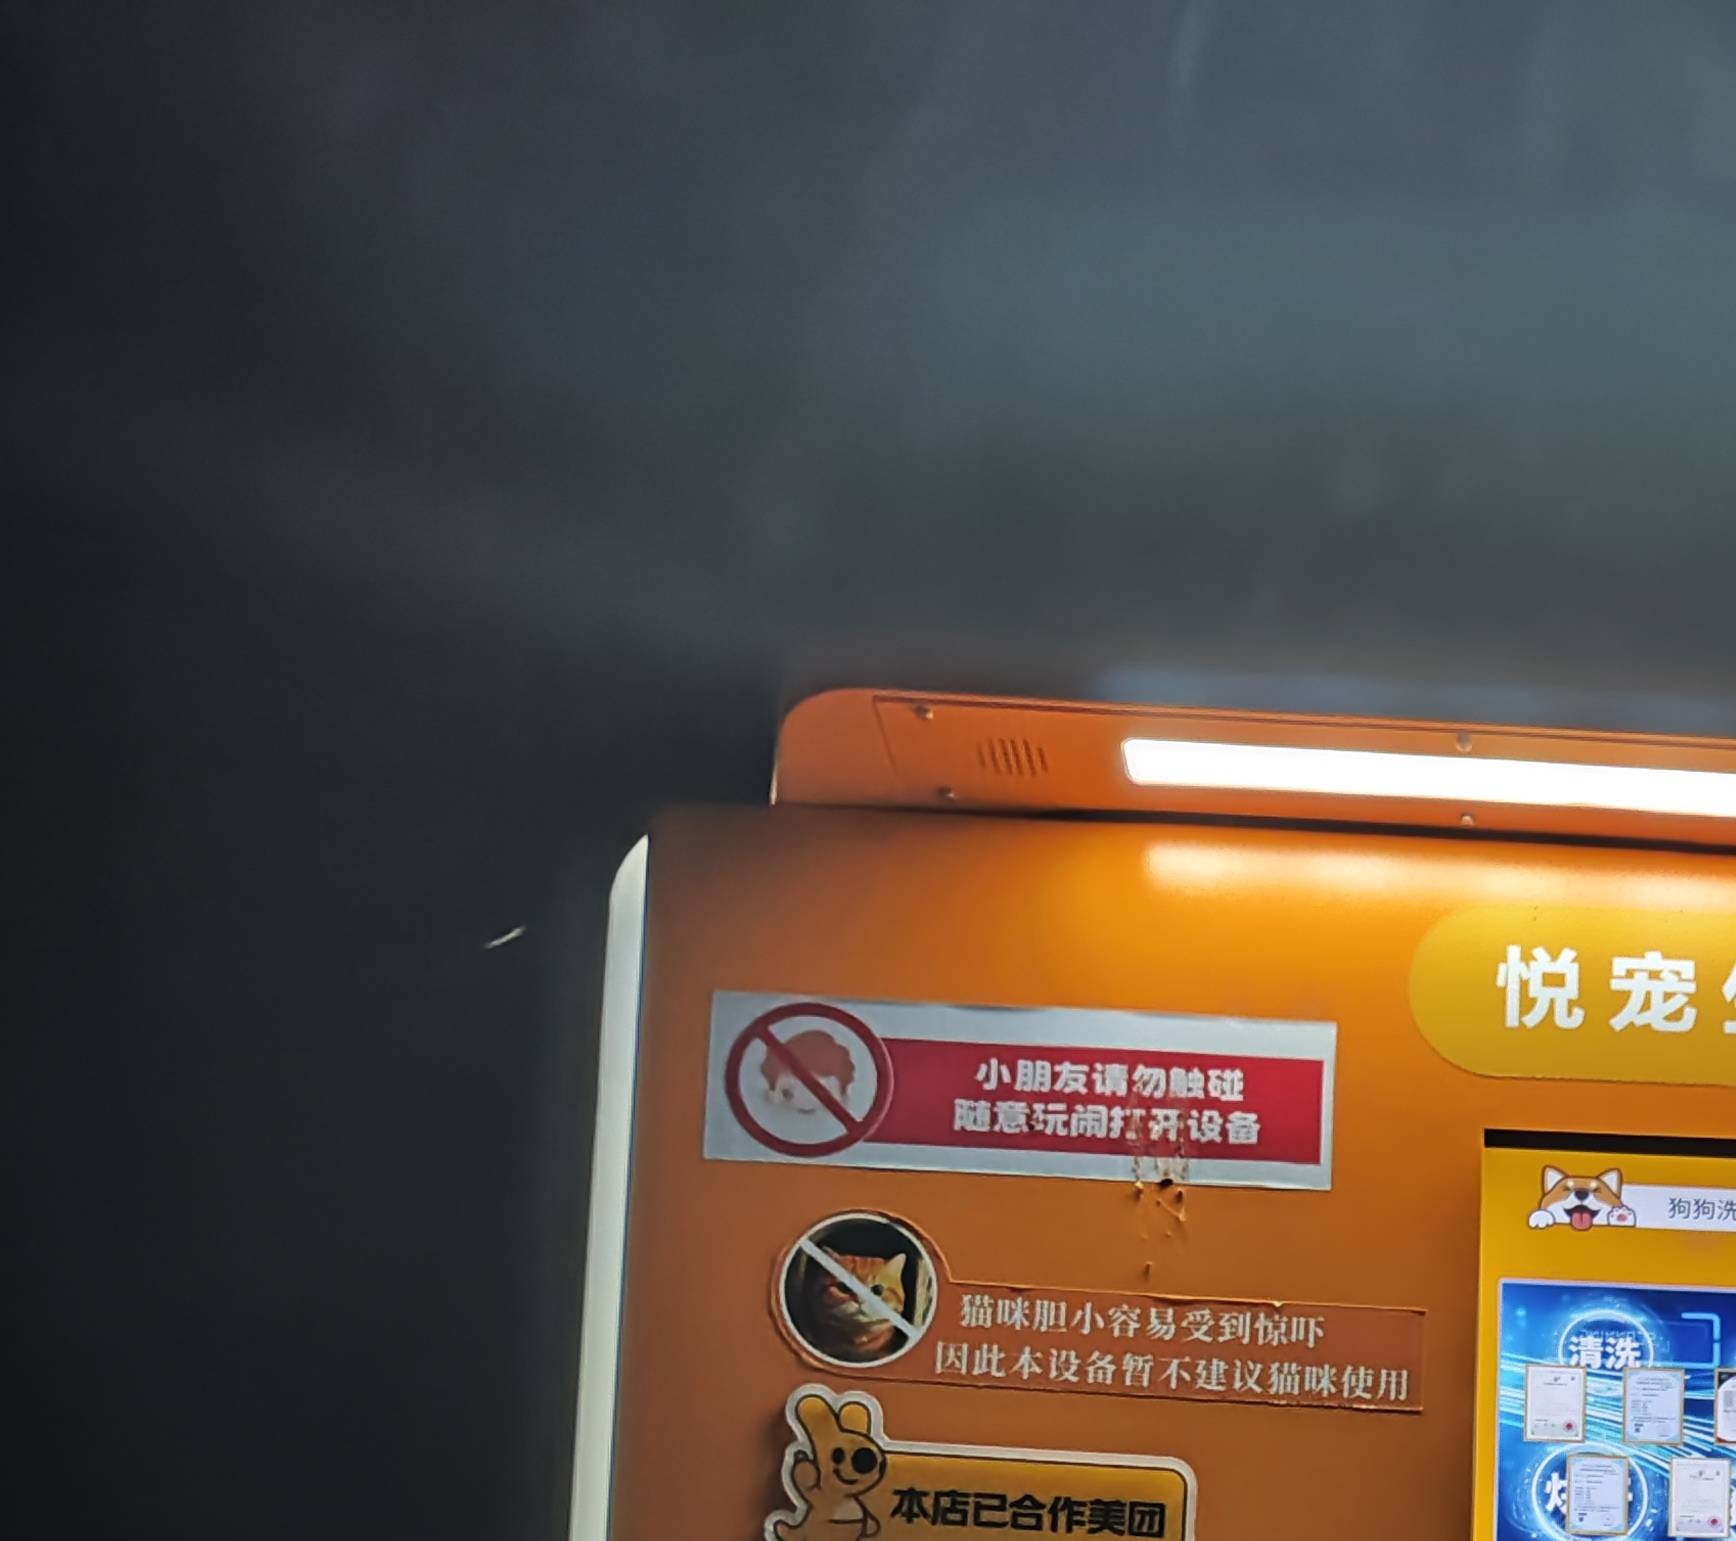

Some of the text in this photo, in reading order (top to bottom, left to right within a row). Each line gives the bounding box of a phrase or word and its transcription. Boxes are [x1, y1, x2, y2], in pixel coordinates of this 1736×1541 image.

[975, 1057, 1244, 1102] 小朋友请勿触碰
[953, 1098, 1261, 1145] 随意玩闹打开设备
[960, 1294, 1326, 1349] 猫咪胆小容易受到惊吓
[935, 1341, 1409, 1401] 因此本设备暂不建议猫咪使用
[1569, 1335, 1642, 1370] 清洗
[890, 1487, 1166, 1539] 本店已合作美团
